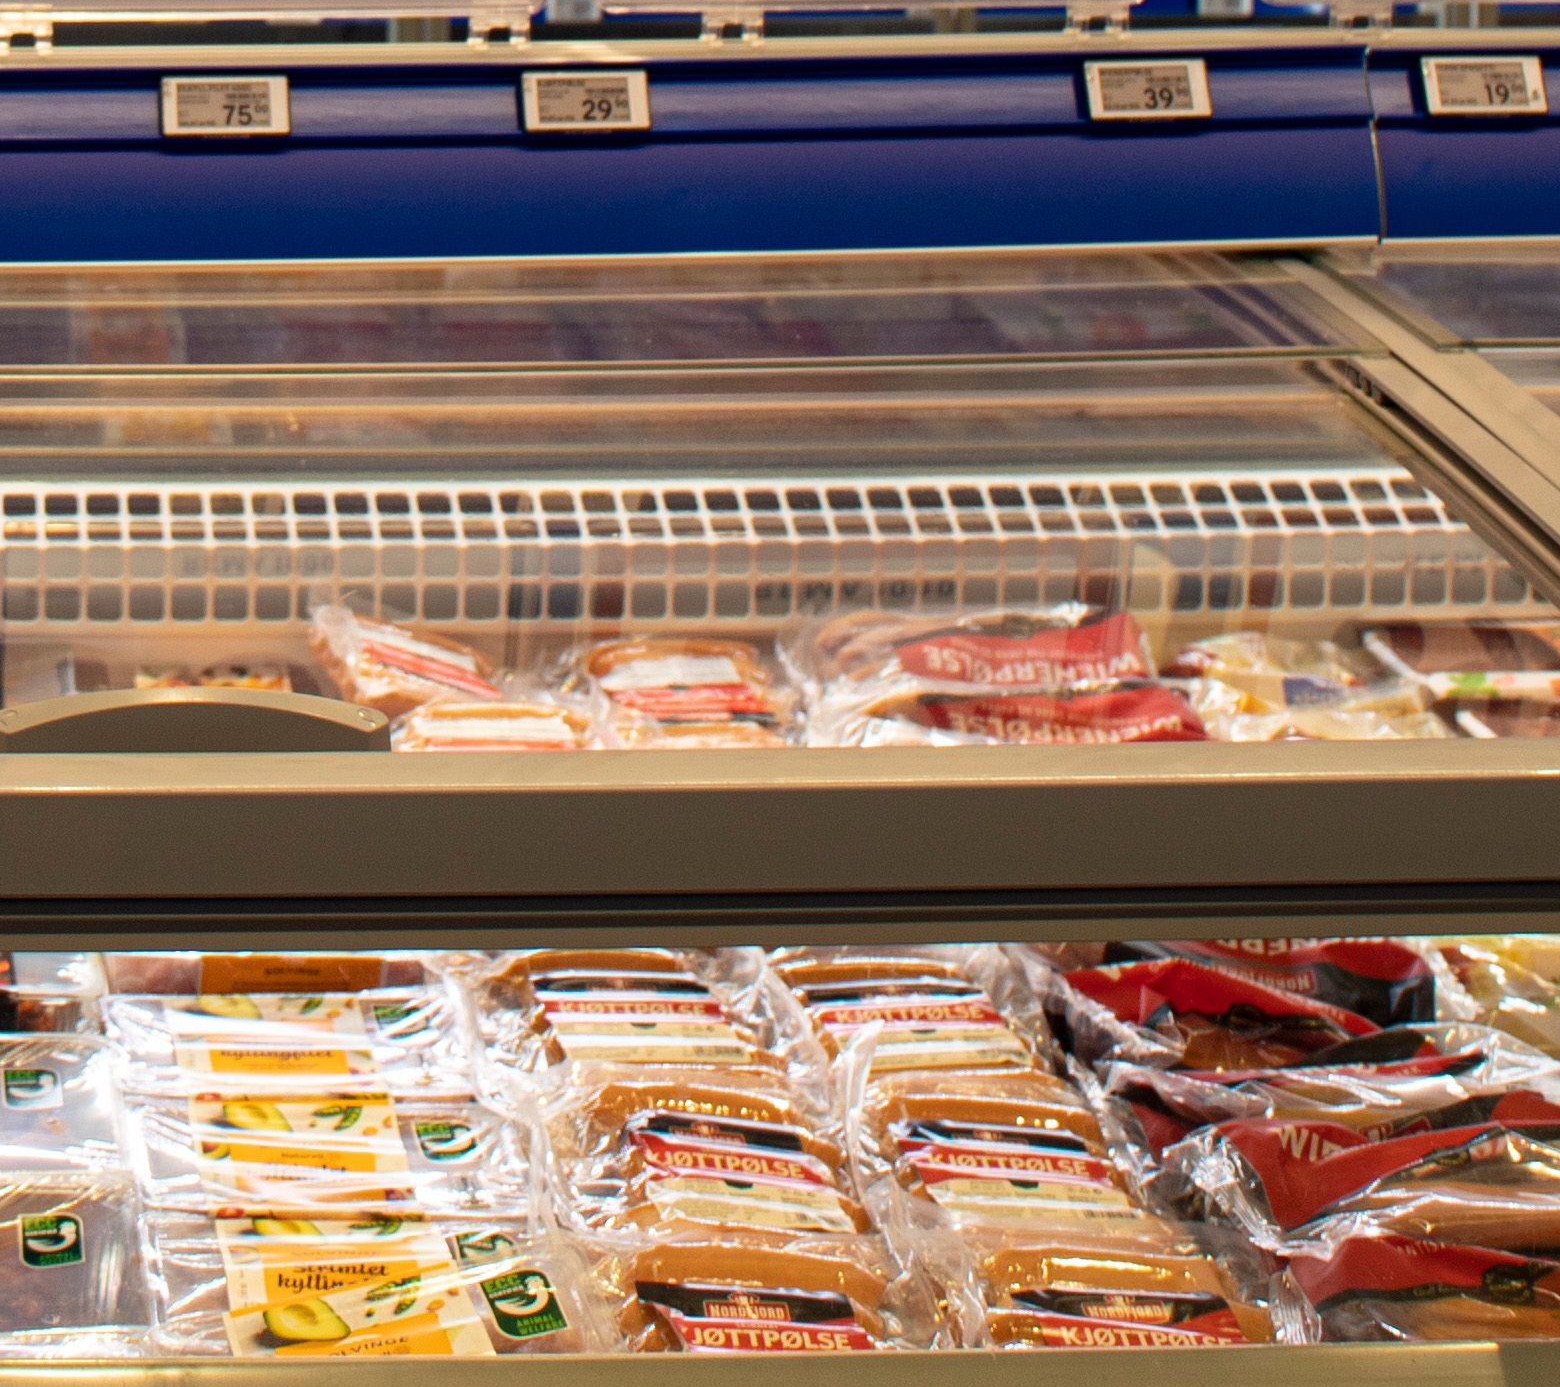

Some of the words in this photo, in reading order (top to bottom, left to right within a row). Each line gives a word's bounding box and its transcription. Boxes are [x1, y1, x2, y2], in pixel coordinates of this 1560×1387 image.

[1144, 89, 1173, 109] 39
[1484, 84, 1509, 104] 19
[582, 100, 611, 121] 29
[646, 1148, 806, 1178] KJØTTPØLSE
[925, 1150, 1091, 1178] KJØTTPØLSE
[710, 1303, 785, 1319] NORDFJORD
